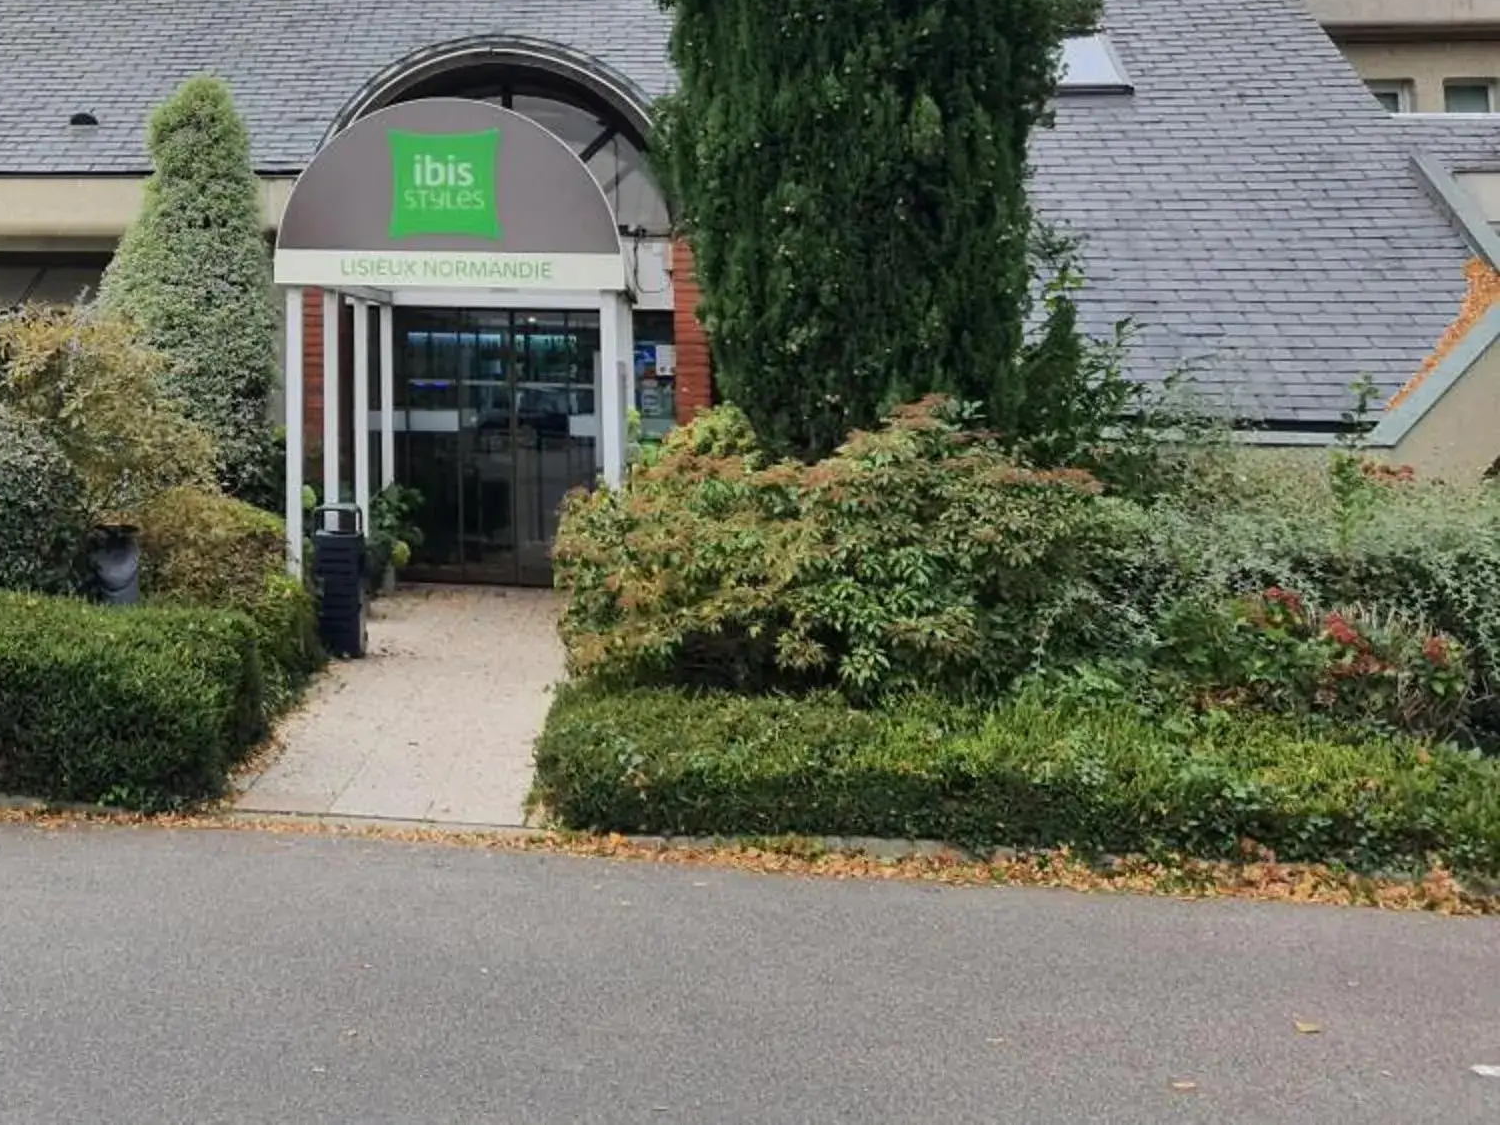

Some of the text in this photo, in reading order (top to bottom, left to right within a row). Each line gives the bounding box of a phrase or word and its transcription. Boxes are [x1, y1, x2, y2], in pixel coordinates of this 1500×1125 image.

[414, 154, 474, 186] ibis
[341, 258, 553, 279] LISIEUX NORMANDIE
